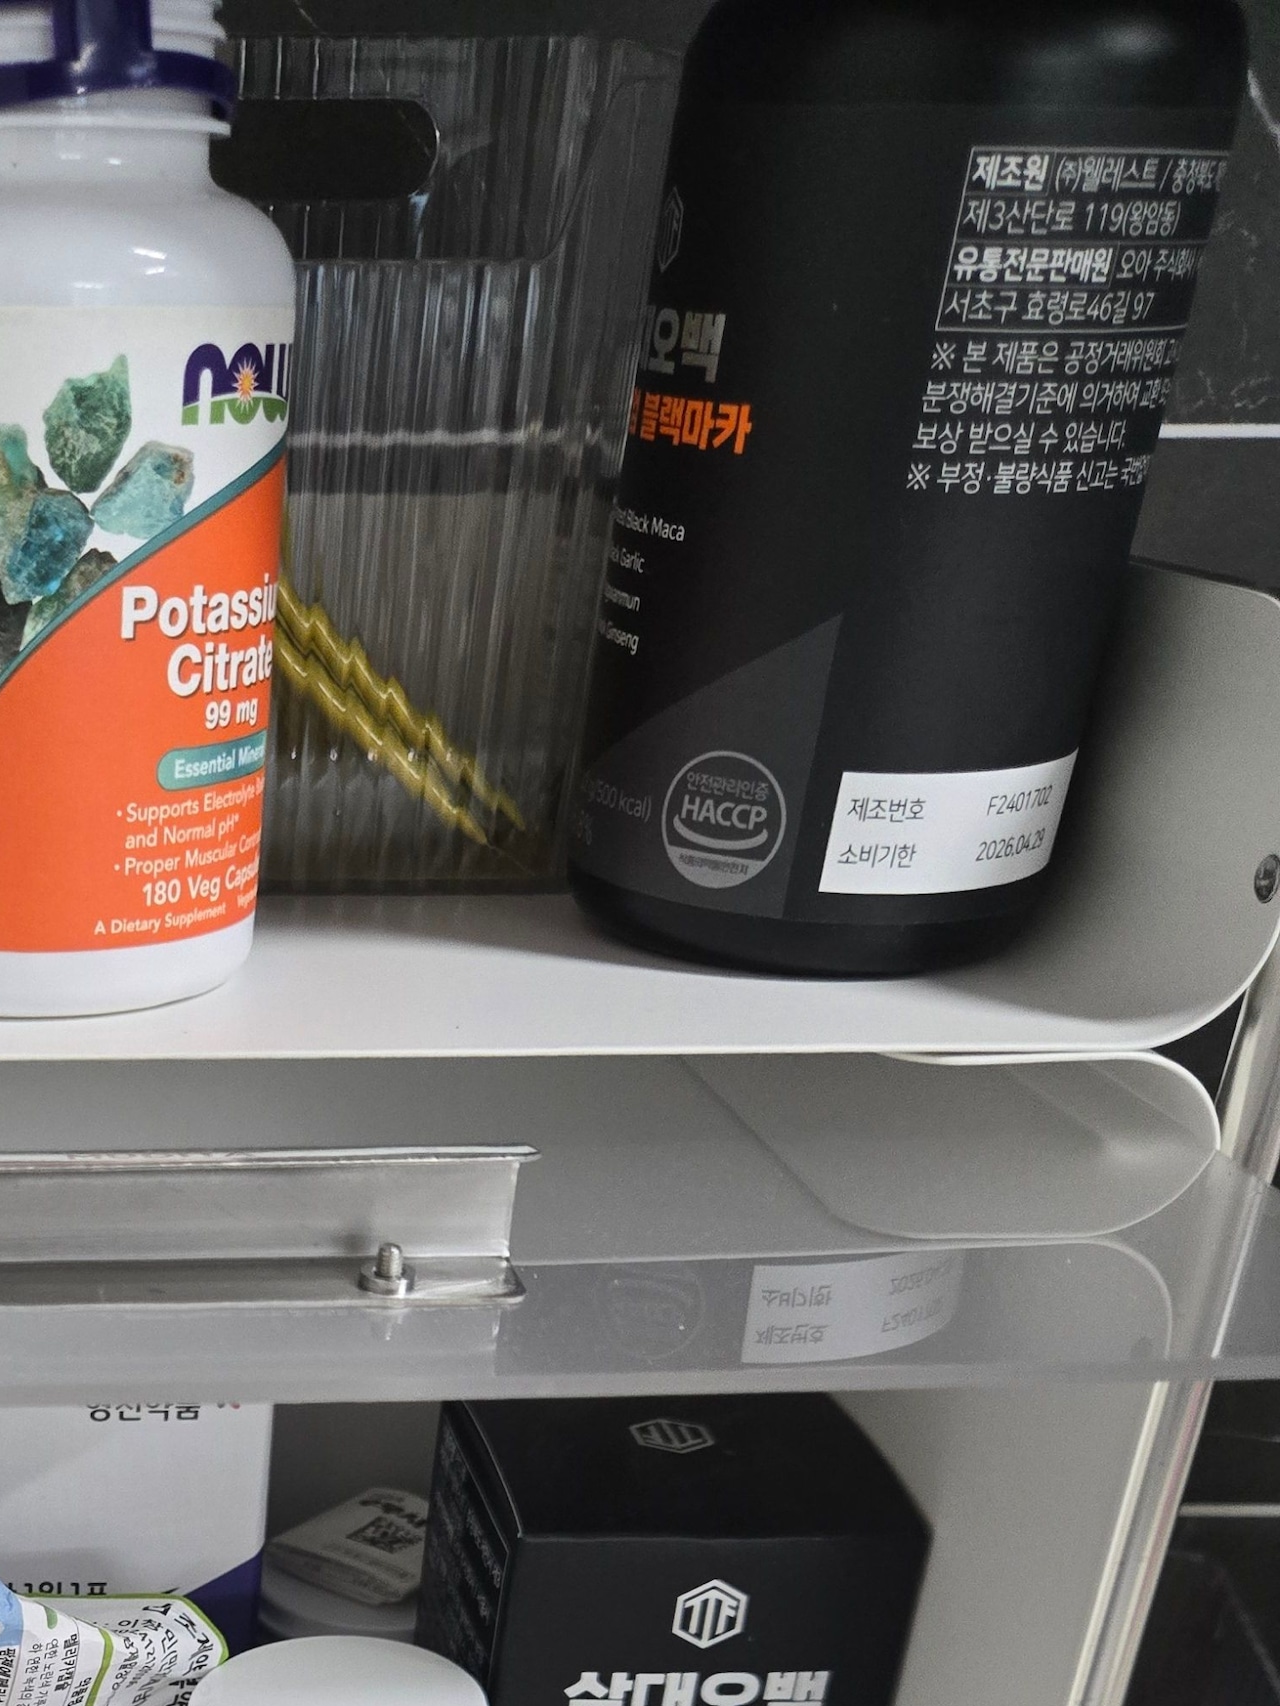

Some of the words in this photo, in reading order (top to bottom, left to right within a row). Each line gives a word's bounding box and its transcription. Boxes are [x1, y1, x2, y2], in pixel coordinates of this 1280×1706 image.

[971, 154, 1050, 191] 제조원
[963, 199, 1075, 236] 제3산단로
[1084, 200, 1181, 236] 119(왕암동)
[953, 246, 1113, 282] 유통전문판매원
[1117, 248, 1152, 280] 오아
[945, 289, 1018, 323] 서초구
[1022, 289, 1131, 325] 효령로46길
[1134, 291, 1155, 321] 97
[962, 341, 987, 374] 본
[992, 340, 1059, 374] 제품은
[1064, 339, 1168, 375] 공정거래위원회
[922, 380, 1077, 415] 분쟁해결기준에
[1079, 378, 1141, 413] 의거하여
[640, 391, 752, 455] 블랙마카
[912, 422, 963, 455] 보상
[969, 421, 1035, 454] 받으실
[1038, 421, 1059, 454] 수
[1063, 420, 1126, 453] 있습니다.
[936, 459, 1073, 495] 부정·불량식품
[1076, 458, 1119, 491] 신고는
[650, 516, 686, 542] Maca
[621, 547, 645, 574] Garlic
[121, 573, 277, 639] Potassiu
[168, 634, 273, 698] Citrate
[205, 699, 231, 730] 99
[236, 697, 258, 726] mg
[174, 750, 235, 780] Essential
[126, 795, 199, 827] Supports
[204, 783, 255, 813] Electrolyte
[681, 794, 768, 830] HACCP
[848, 798, 926, 823] 제조번호
[986, 784, 1053, 818] F2401702
[125, 825, 157, 850] and
[163, 820, 215, 845] Normal
[836, 843, 917, 869] 소비기한
[976, 828, 1046, 863] 2026.04.29
[124, 855, 180, 882] Proper
[185, 842, 237, 869] Muscular
[142, 882, 181, 907] 180
[188, 875, 221, 902] Veg
[94, 920, 106, 935] A
[111, 916, 161, 935] Dietary
[164, 903, 226, 928] Supplement
[54, 1633, 78, 1692] 멜리카캡슐
[67, 1677, 92, 1706] 약품명
